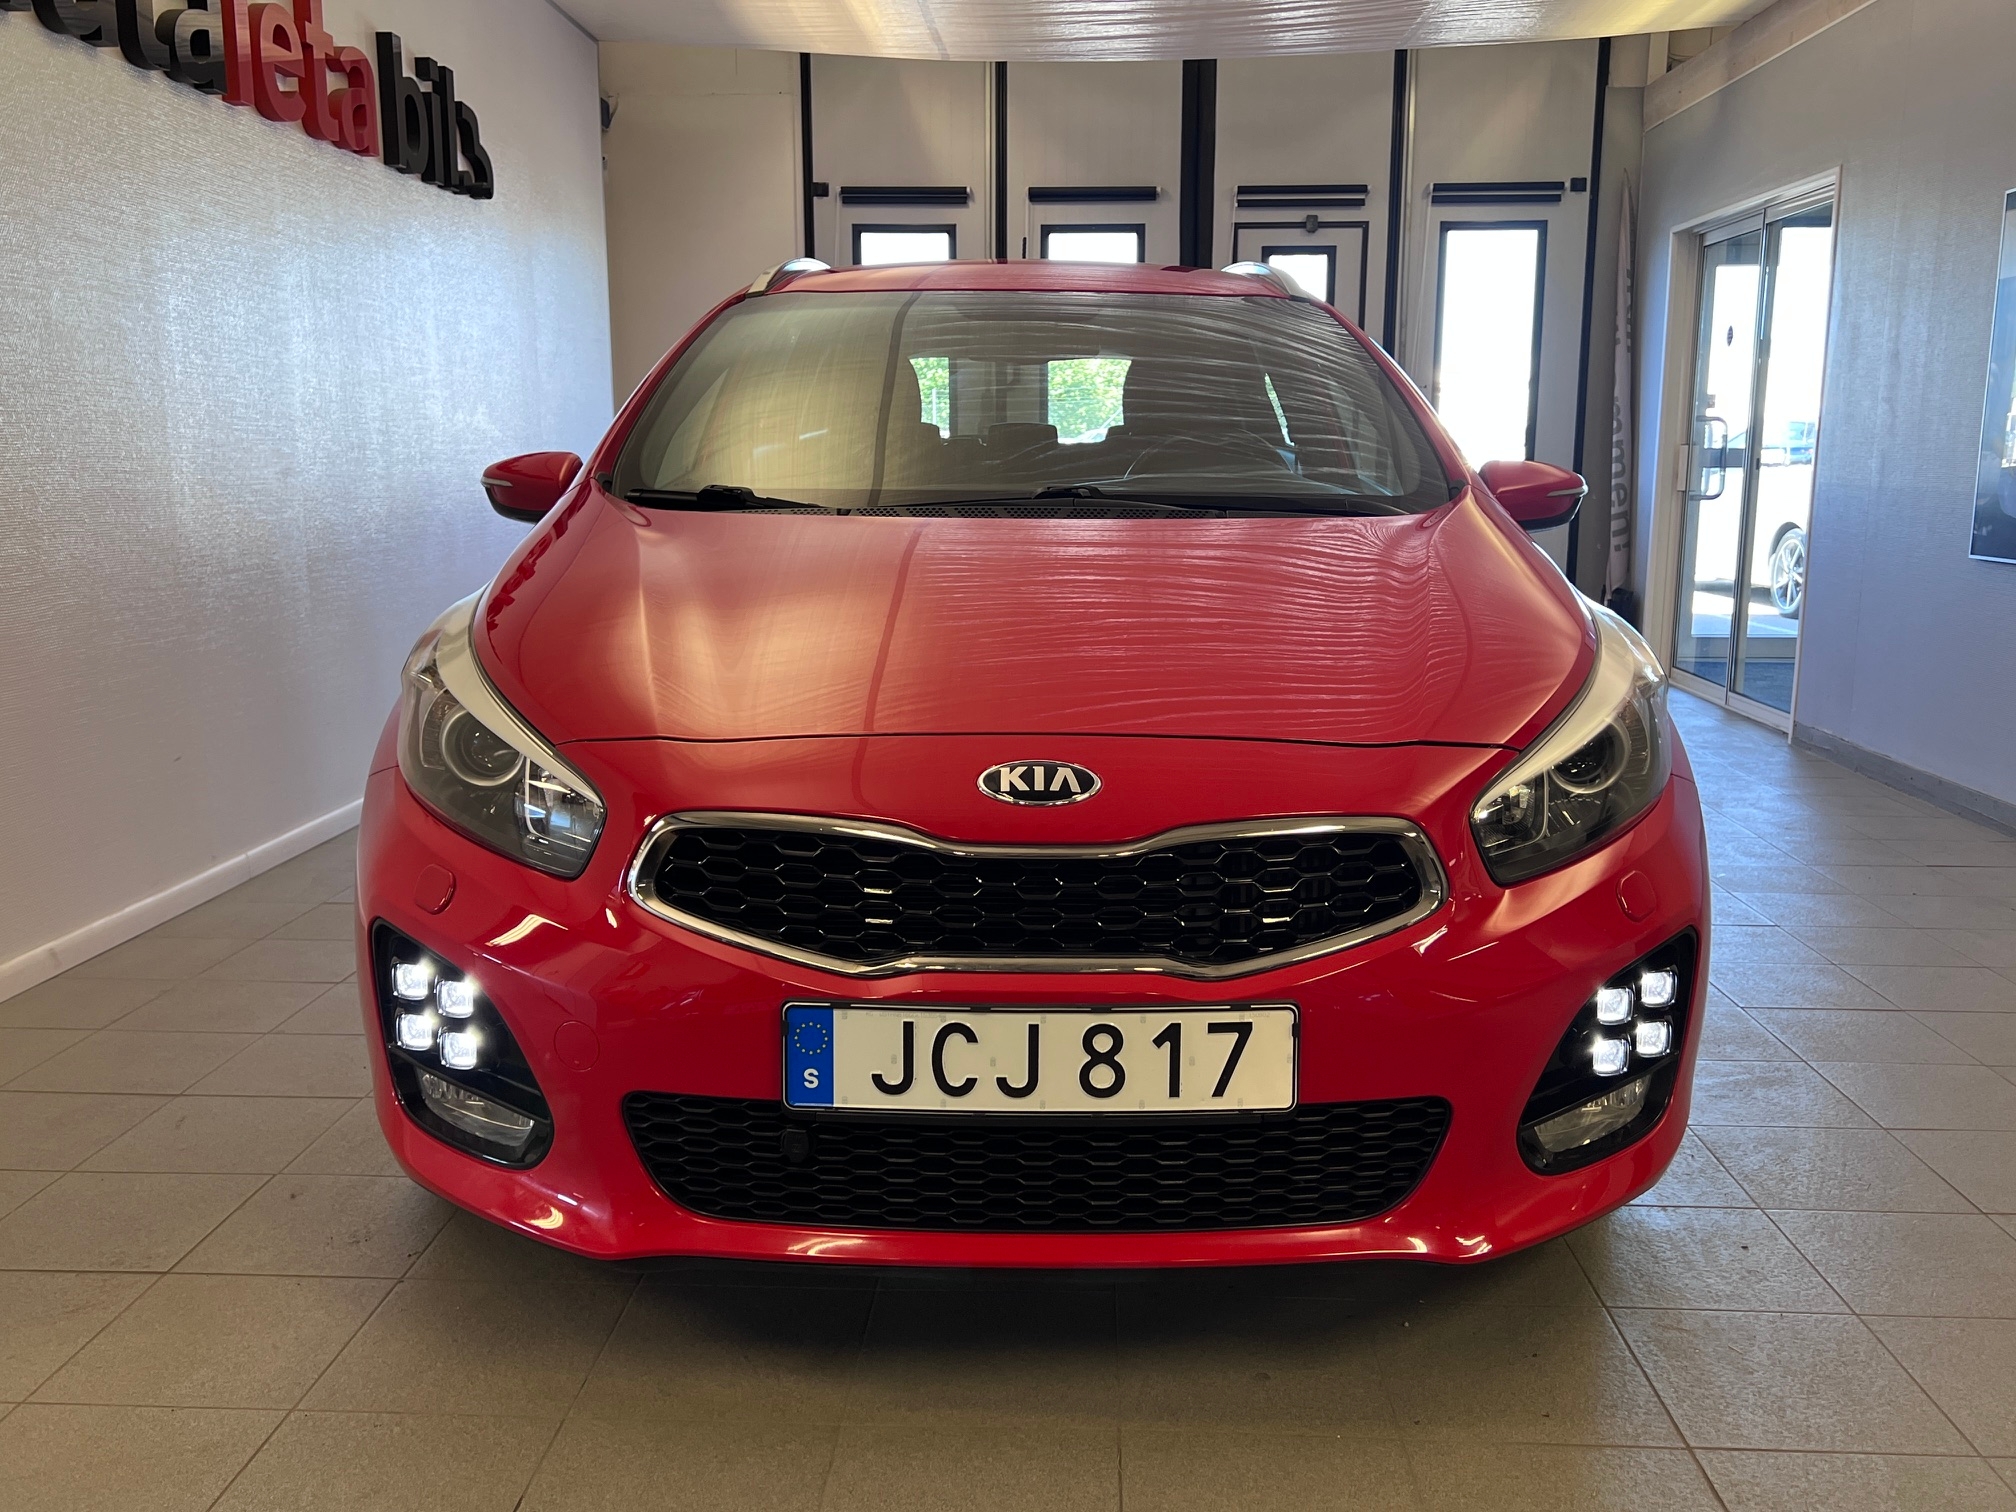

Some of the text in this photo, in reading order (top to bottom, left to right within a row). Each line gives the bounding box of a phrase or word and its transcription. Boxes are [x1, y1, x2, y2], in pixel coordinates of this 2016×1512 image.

[999, 766, 1081, 792] KIA
[871, 1020, 1254, 1099] JCJ 817
[803, 1068, 819, 1089] S
